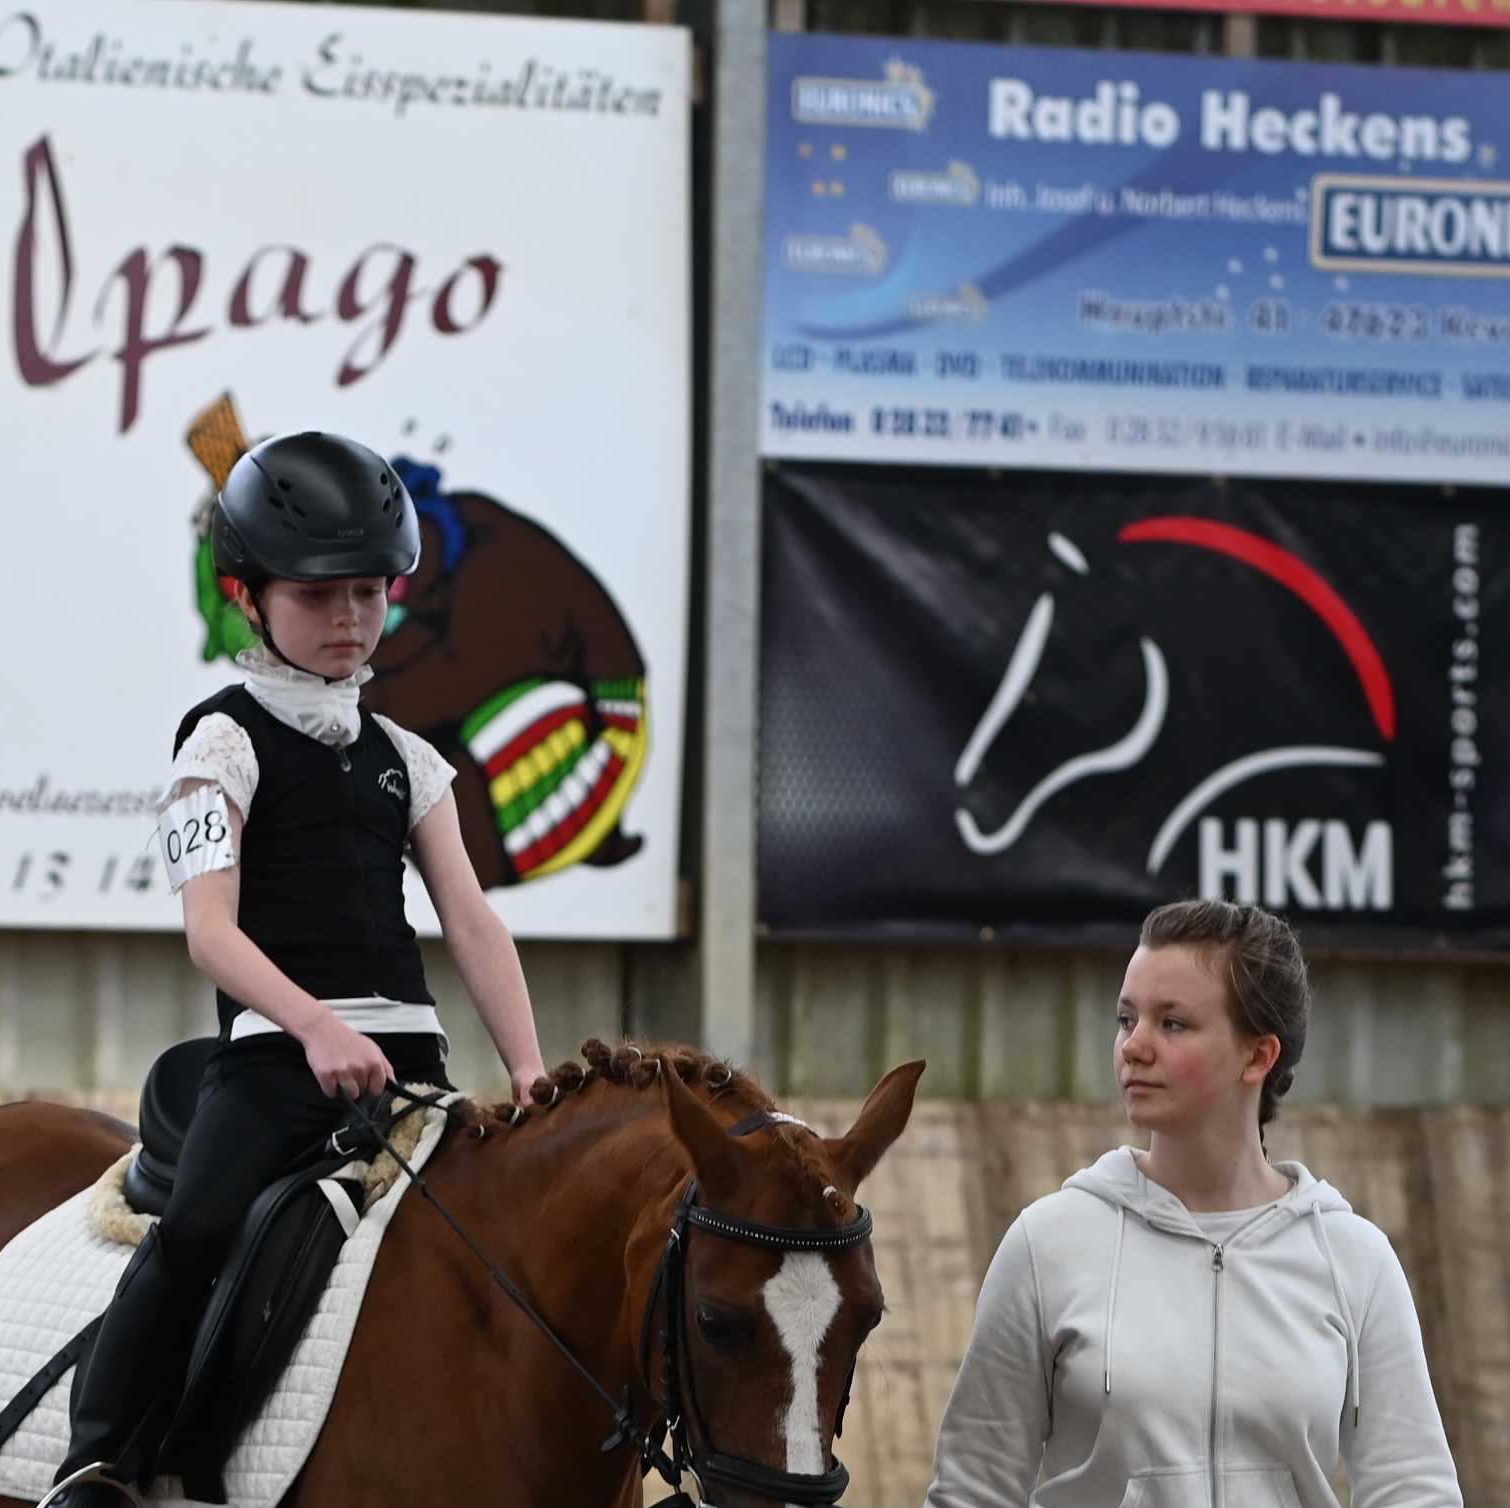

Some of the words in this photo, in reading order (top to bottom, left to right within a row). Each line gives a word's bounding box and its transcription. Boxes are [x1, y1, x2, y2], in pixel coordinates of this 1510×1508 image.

[301, 32, 663, 119] Eisspezialitäten
[988, 77, 1181, 149] Radio
[1201, 90, 1473, 164] Heckens
[1442, 523, 1482, 911] hkm-sports.com
[167, 810, 227, 864] 028
[1199, 817, 1394, 911] HKM
